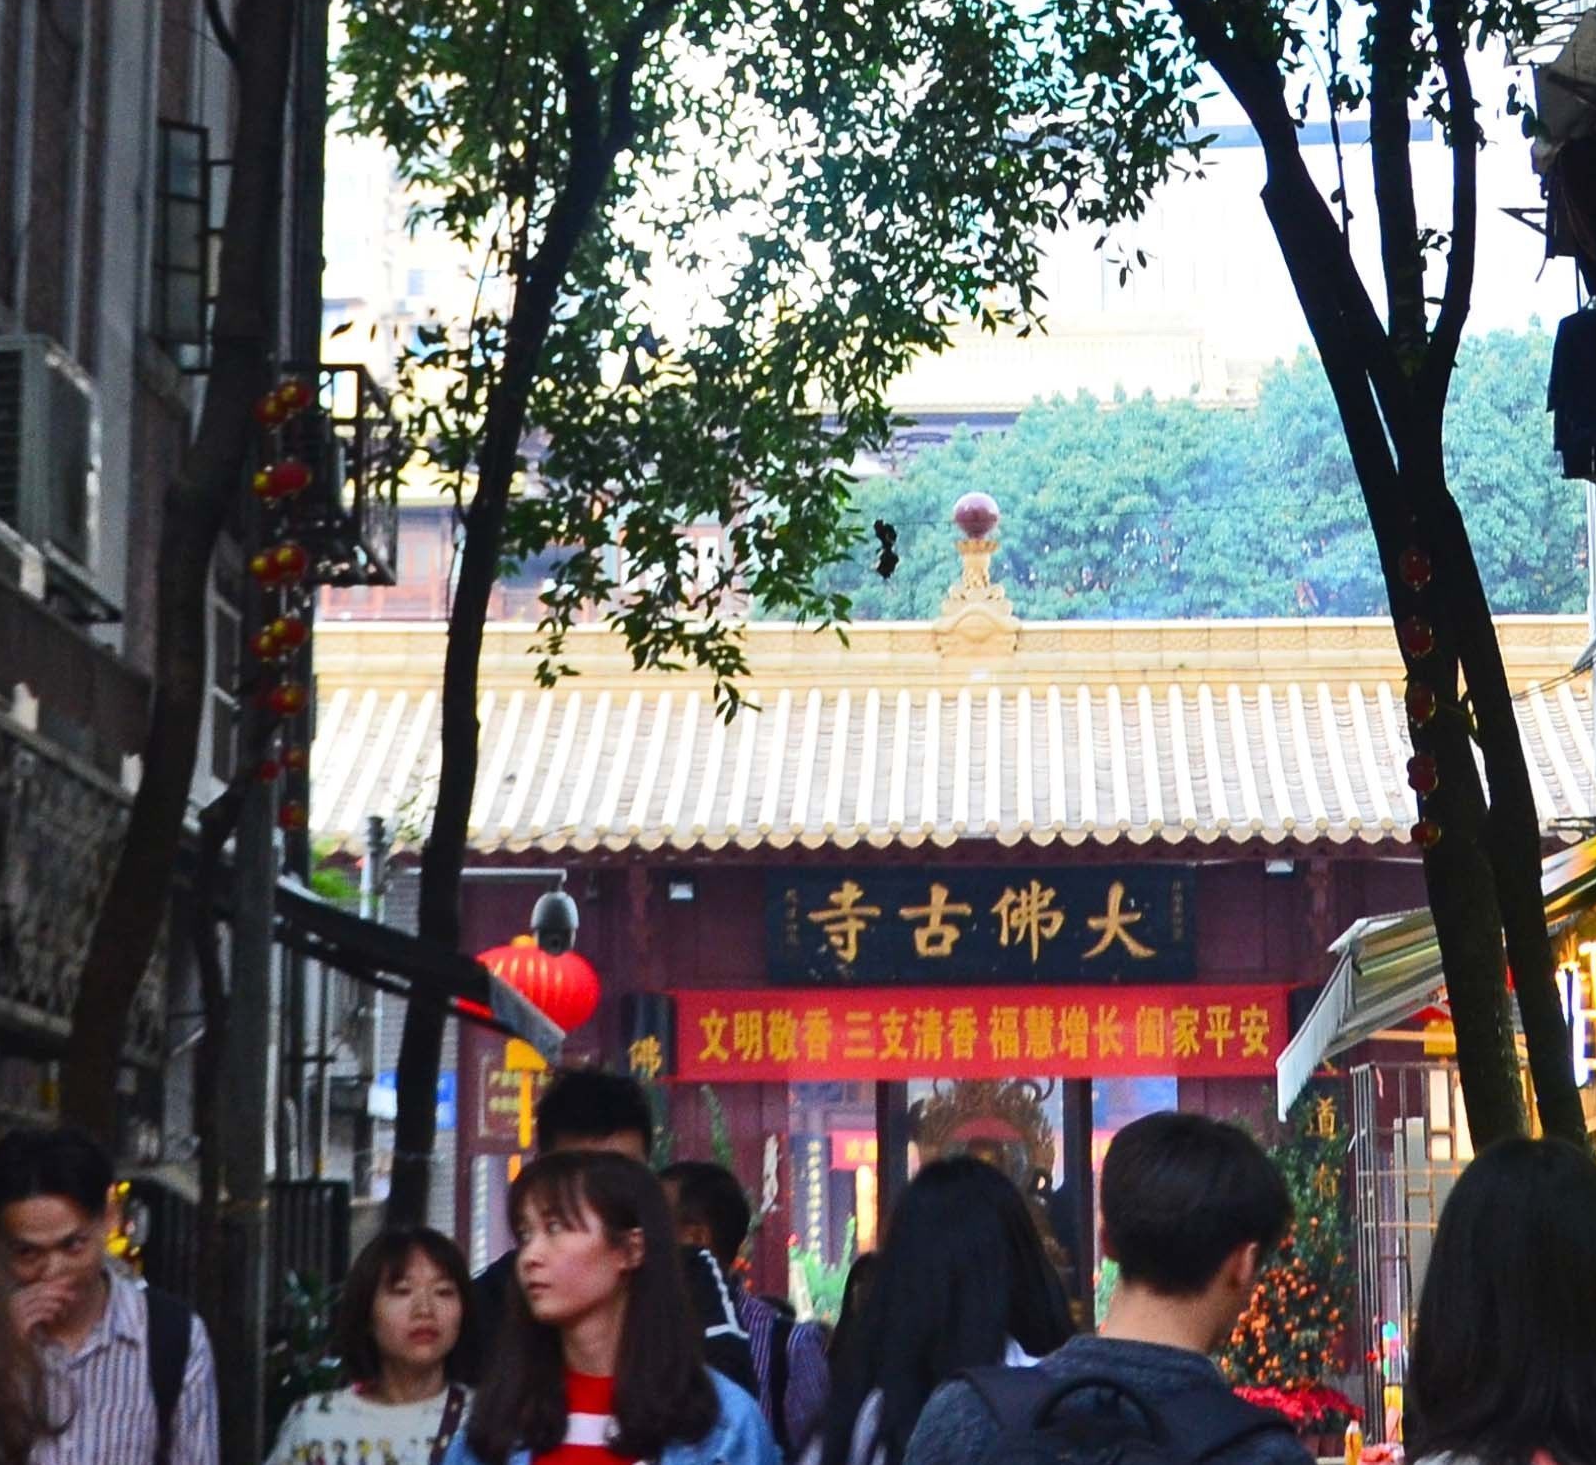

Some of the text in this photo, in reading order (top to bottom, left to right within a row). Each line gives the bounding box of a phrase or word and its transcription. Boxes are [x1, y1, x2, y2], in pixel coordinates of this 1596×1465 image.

[699, 1008, 834, 1063] 文明敬香
[842, 1007, 978, 1061] 三支清香
[989, 1004, 1124, 1061] 福慧增长
